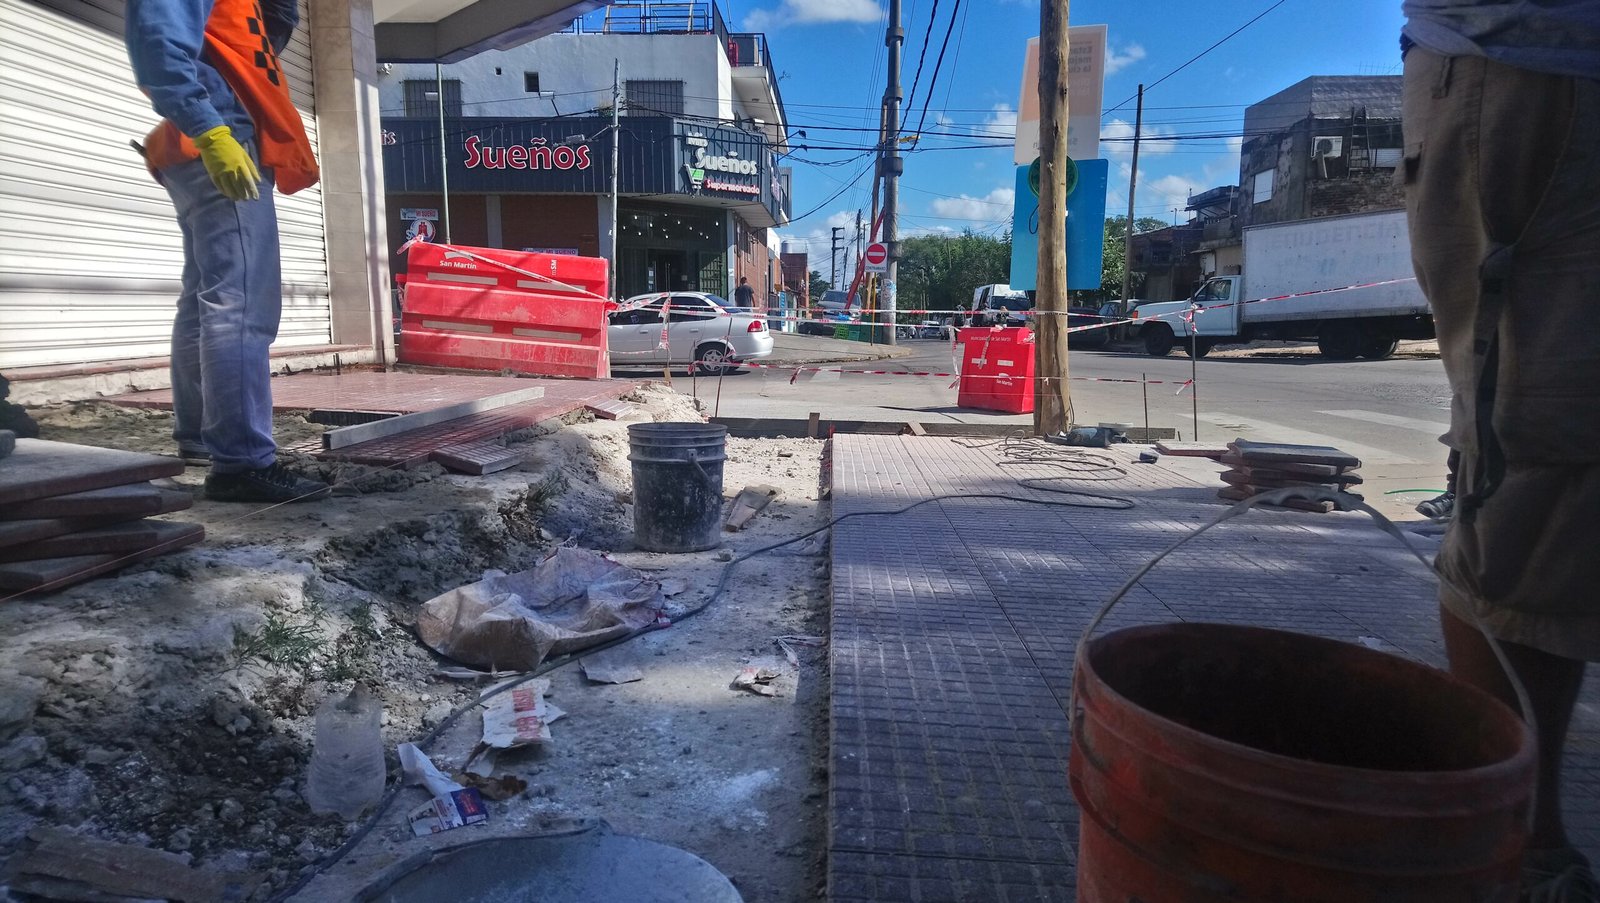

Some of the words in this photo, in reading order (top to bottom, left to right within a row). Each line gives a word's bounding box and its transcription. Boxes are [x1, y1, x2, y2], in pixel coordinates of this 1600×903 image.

[381, 129, 397, 145] is
[464, 135, 590, 169] Sueños
[695, 147, 758, 175] Sueños
[704, 179, 761, 195] Supermercado
